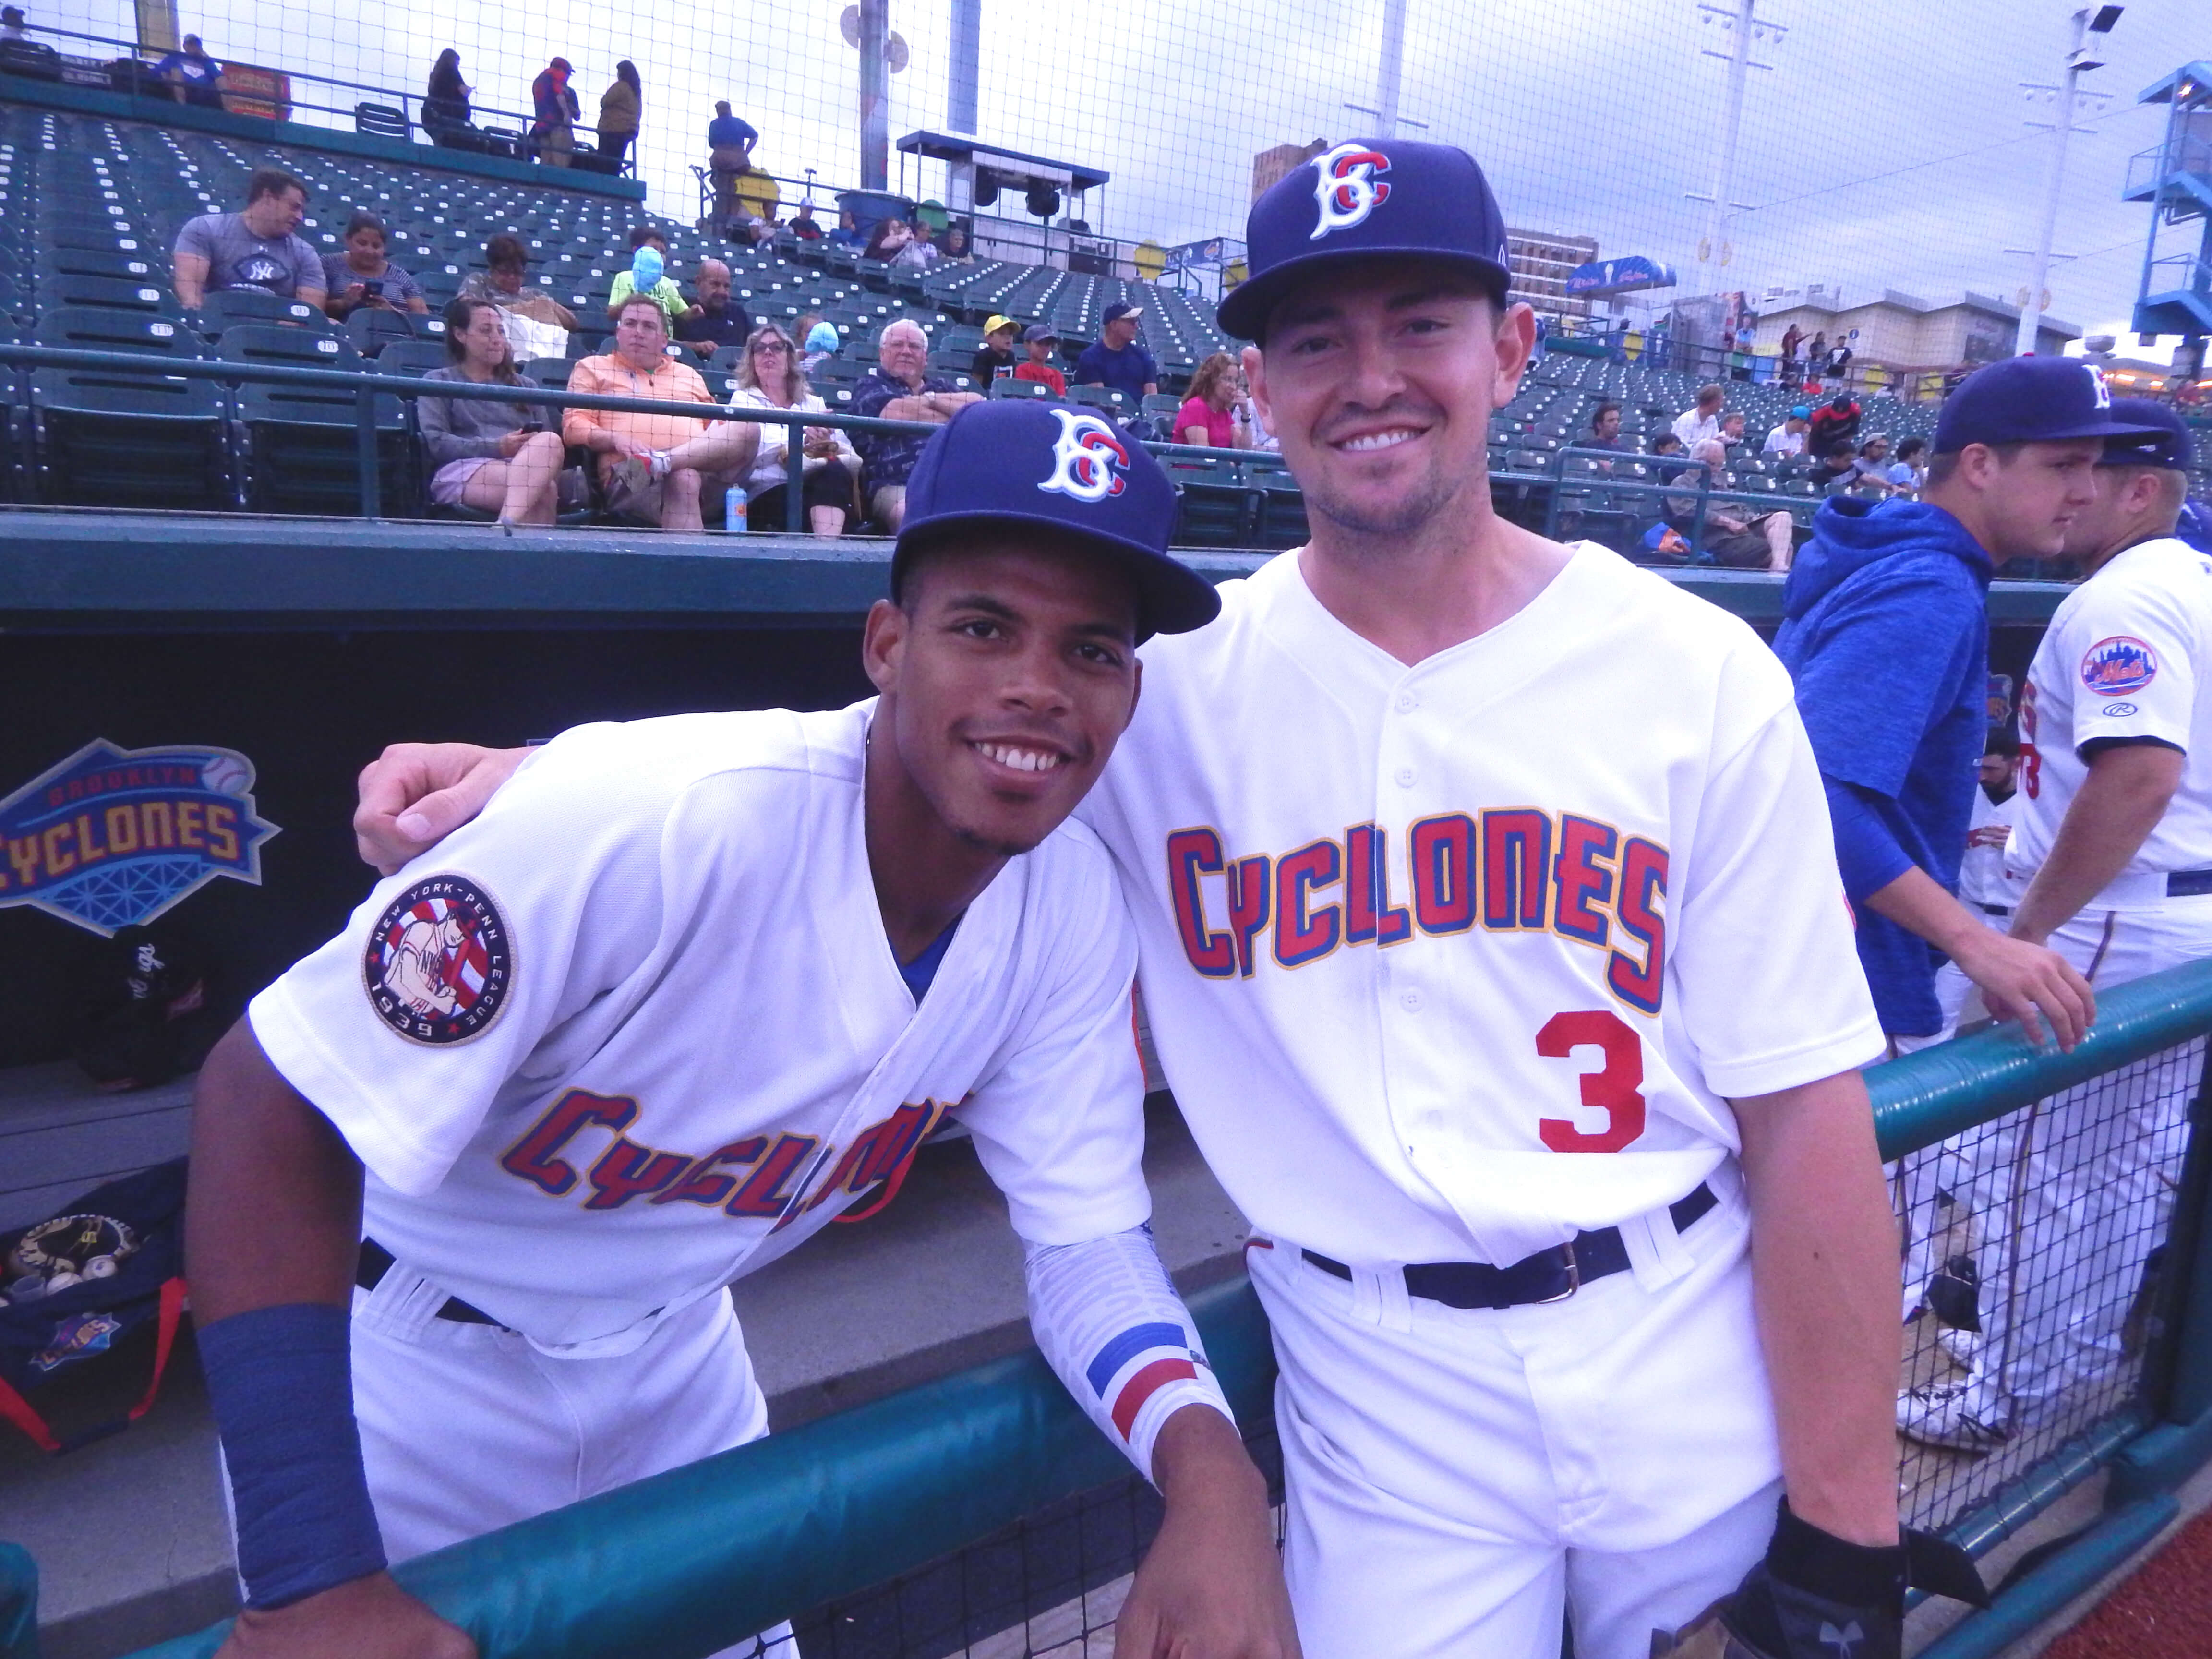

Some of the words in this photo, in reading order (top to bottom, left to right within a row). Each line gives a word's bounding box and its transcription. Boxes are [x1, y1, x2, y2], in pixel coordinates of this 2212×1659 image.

[250, 261, 274, 281] NY
[2094, 658, 2145, 682] Mets
[48, 766, 196, 806] BROOKLYN
[1166, 806, 1670, 1019] CYCLONES
[376, 905, 401, 942] NEW
[466, 955, 502, 1026] LEAGUE
[371, 981, 433, 1037] 1939
[1535, 1010, 1647, 1153] 3
